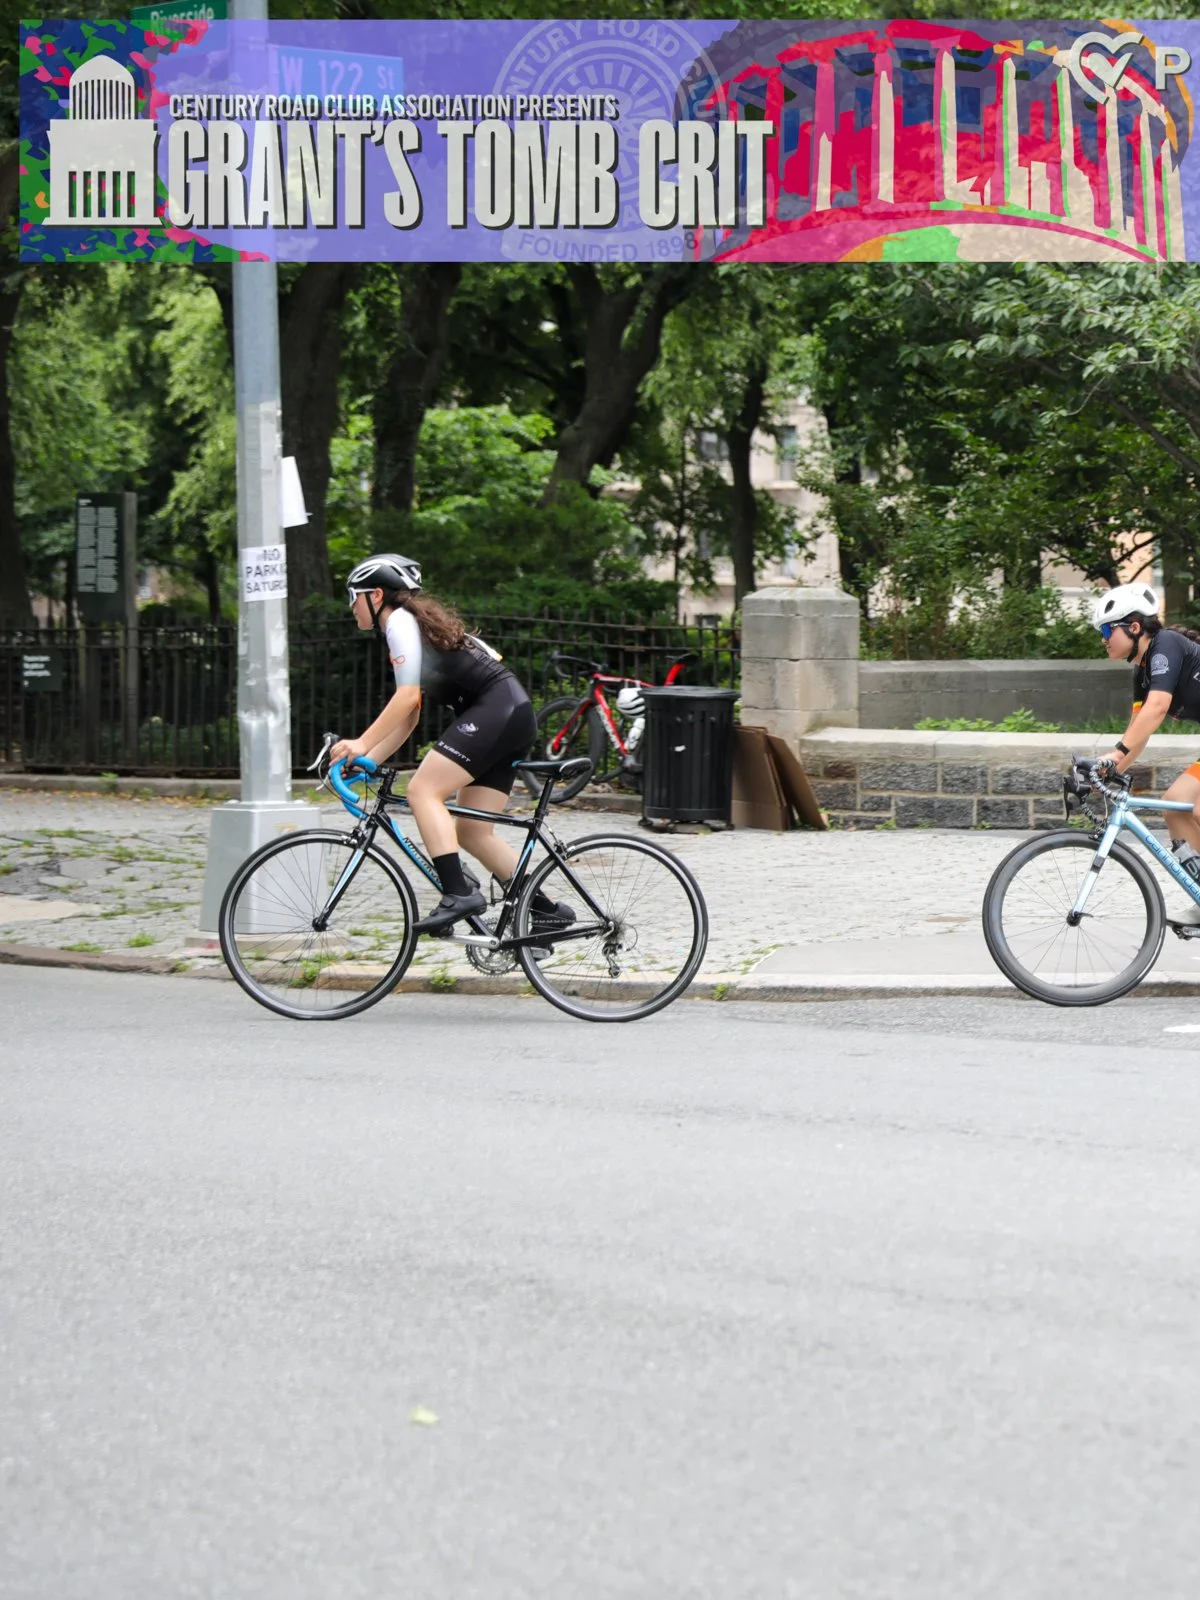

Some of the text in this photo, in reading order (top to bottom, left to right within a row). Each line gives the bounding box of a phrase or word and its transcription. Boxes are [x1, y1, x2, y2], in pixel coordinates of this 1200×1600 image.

[280, 56, 396, 95] W 122 St
